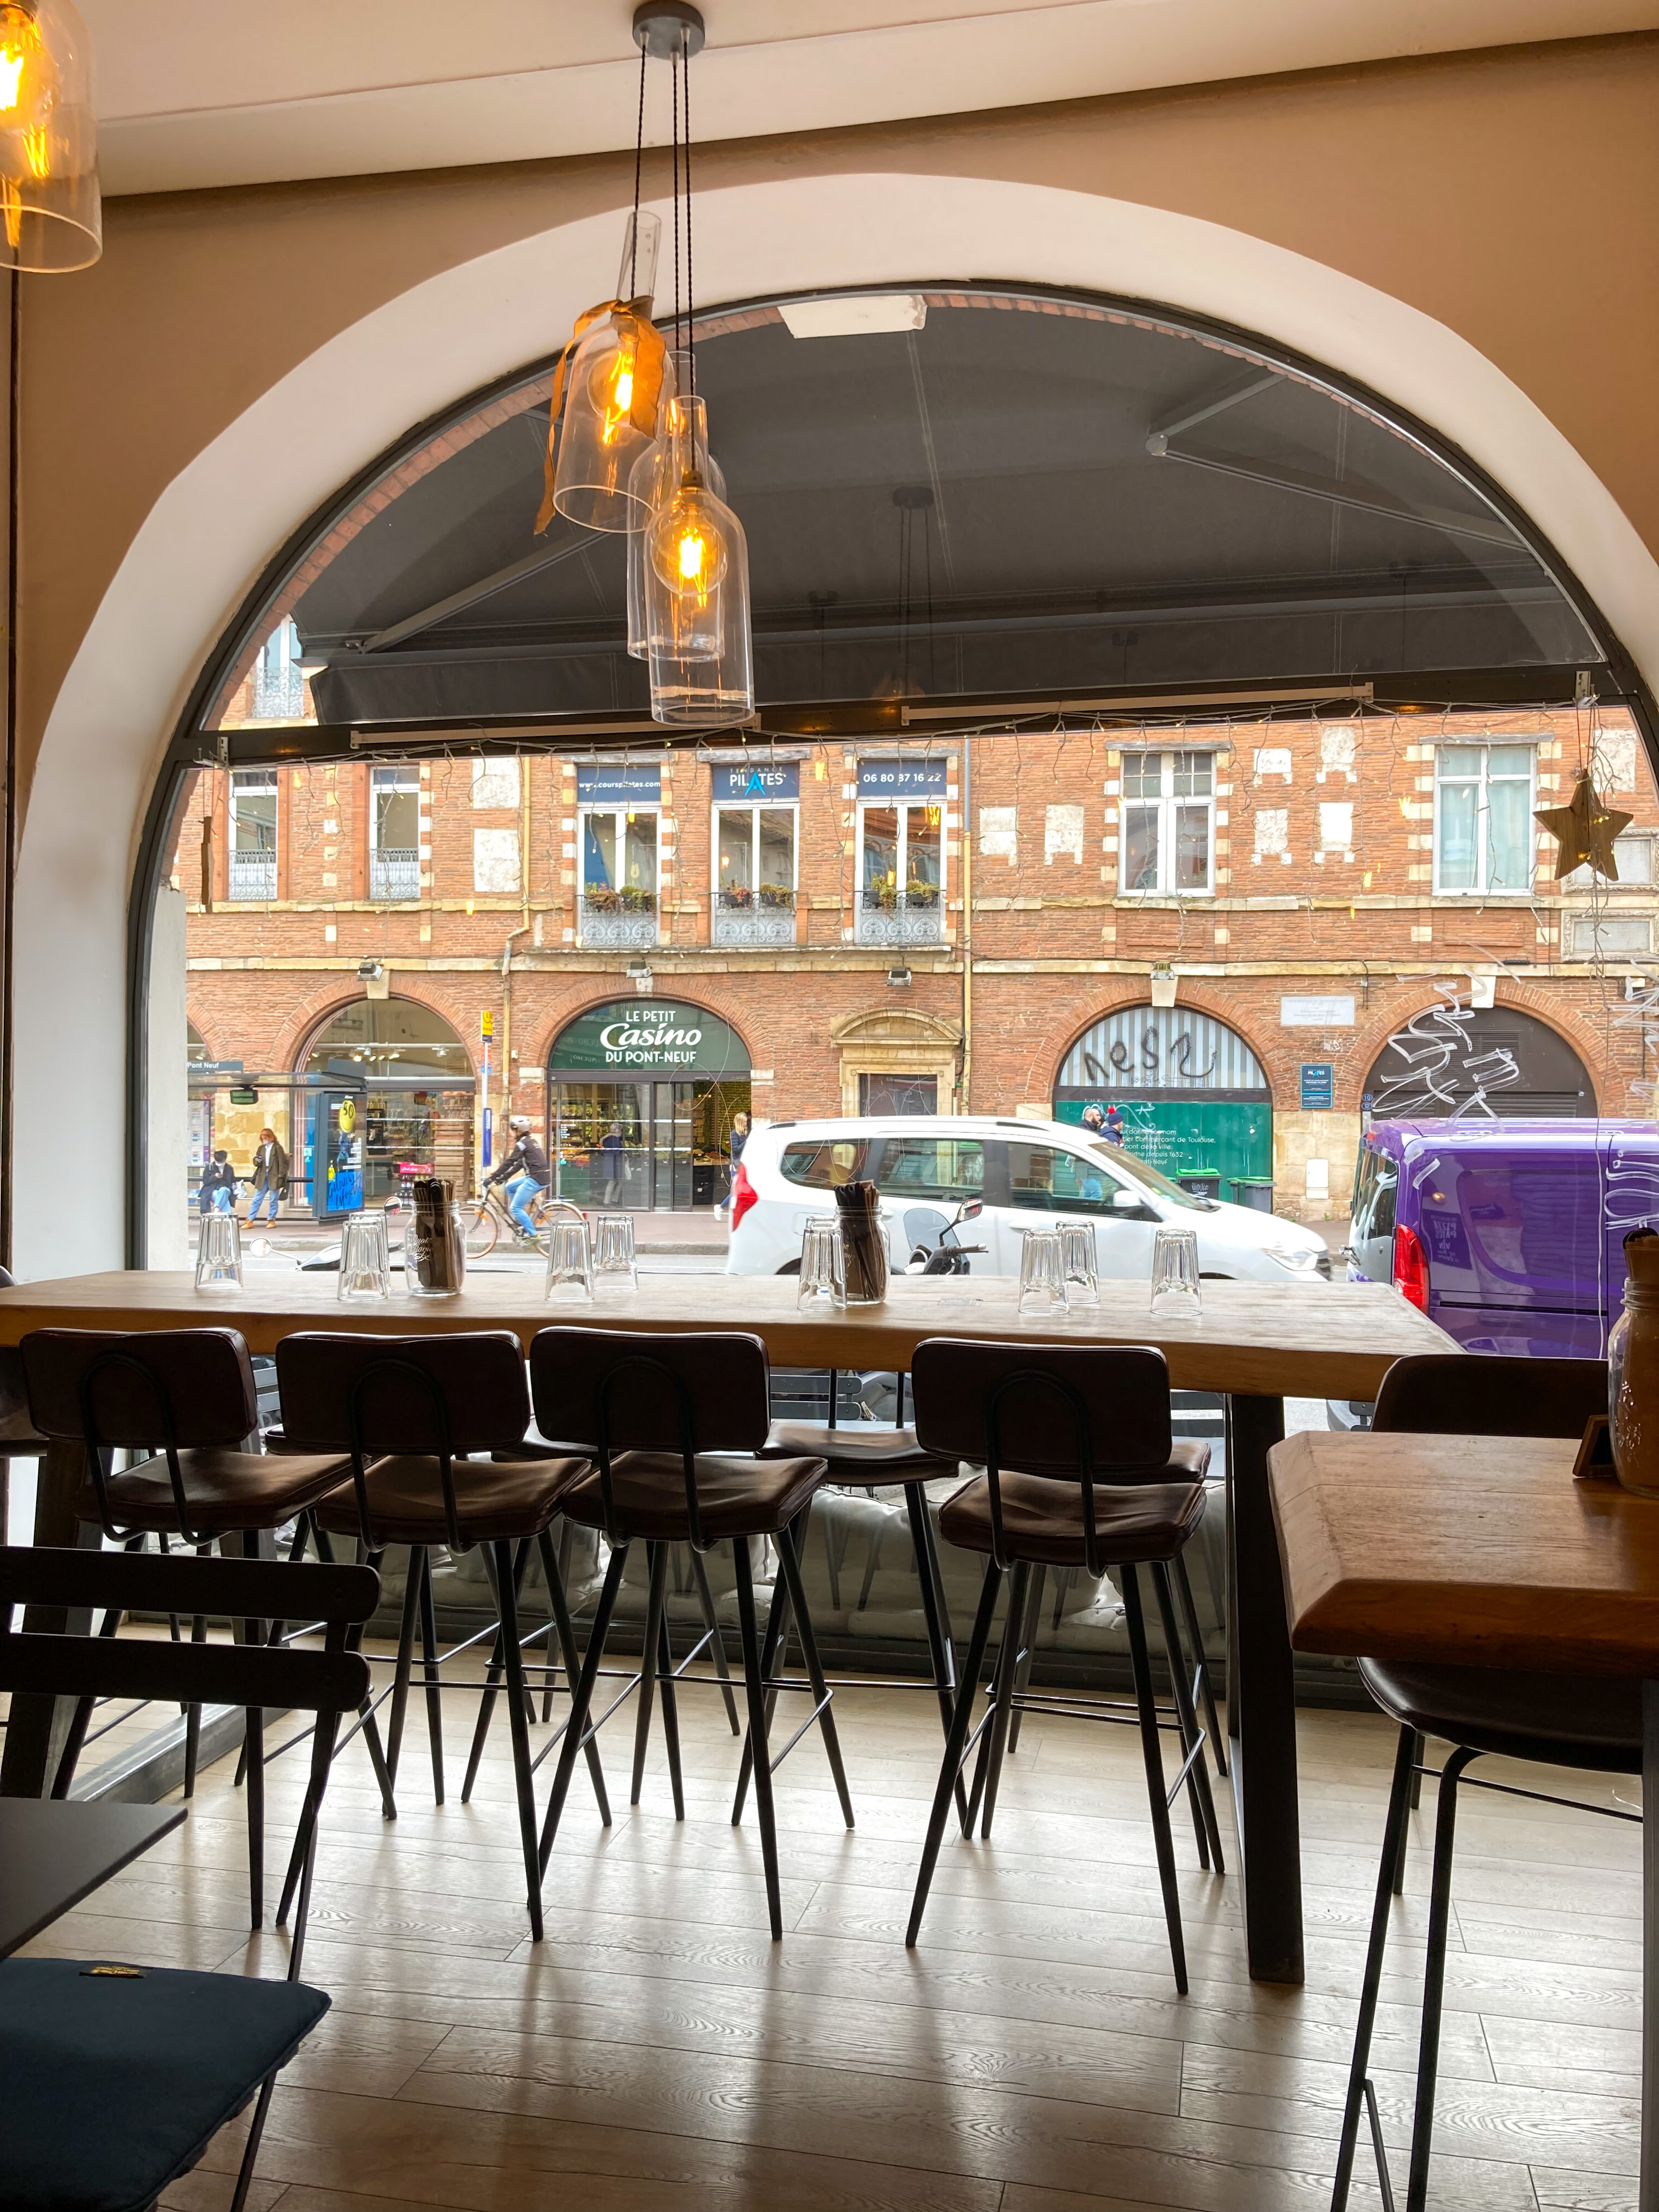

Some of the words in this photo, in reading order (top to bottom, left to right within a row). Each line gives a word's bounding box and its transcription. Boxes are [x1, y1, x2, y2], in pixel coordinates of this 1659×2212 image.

[730, 772, 783, 796] PILATES
[863, 774, 877, 782] 06
[880, 774, 894, 782] 80
[913, 774, 924, 782] 16
[927, 773, 941, 782] 22
[626, 1011, 640, 1022] LE
[643, 1011, 676, 1022] PETIT
[600, 1023, 702, 1051] Casino
[606, 1051, 622, 1063] DU
[626, 1051, 697, 1063] PONT-NEUF
[343, 1102, 354, 1119] 50
